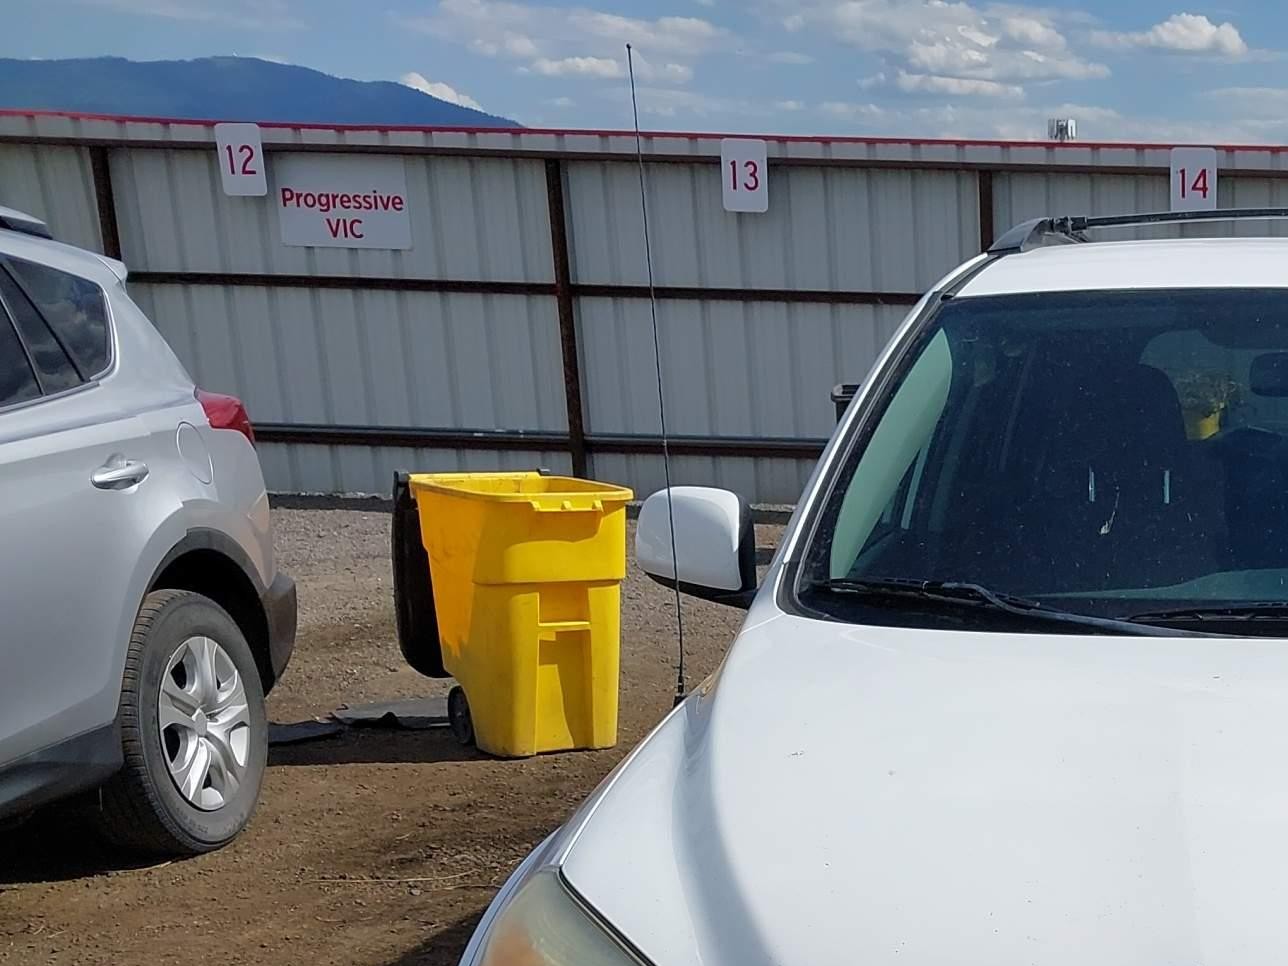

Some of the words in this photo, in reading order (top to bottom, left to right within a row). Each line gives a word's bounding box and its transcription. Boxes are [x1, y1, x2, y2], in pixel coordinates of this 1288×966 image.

[226, 145, 256, 175] 12
[730, 160, 759, 191] 13
[1179, 168, 1208, 199] 14
[281, 187, 404, 213] Progressive
[326, 218, 364, 239] VIC
